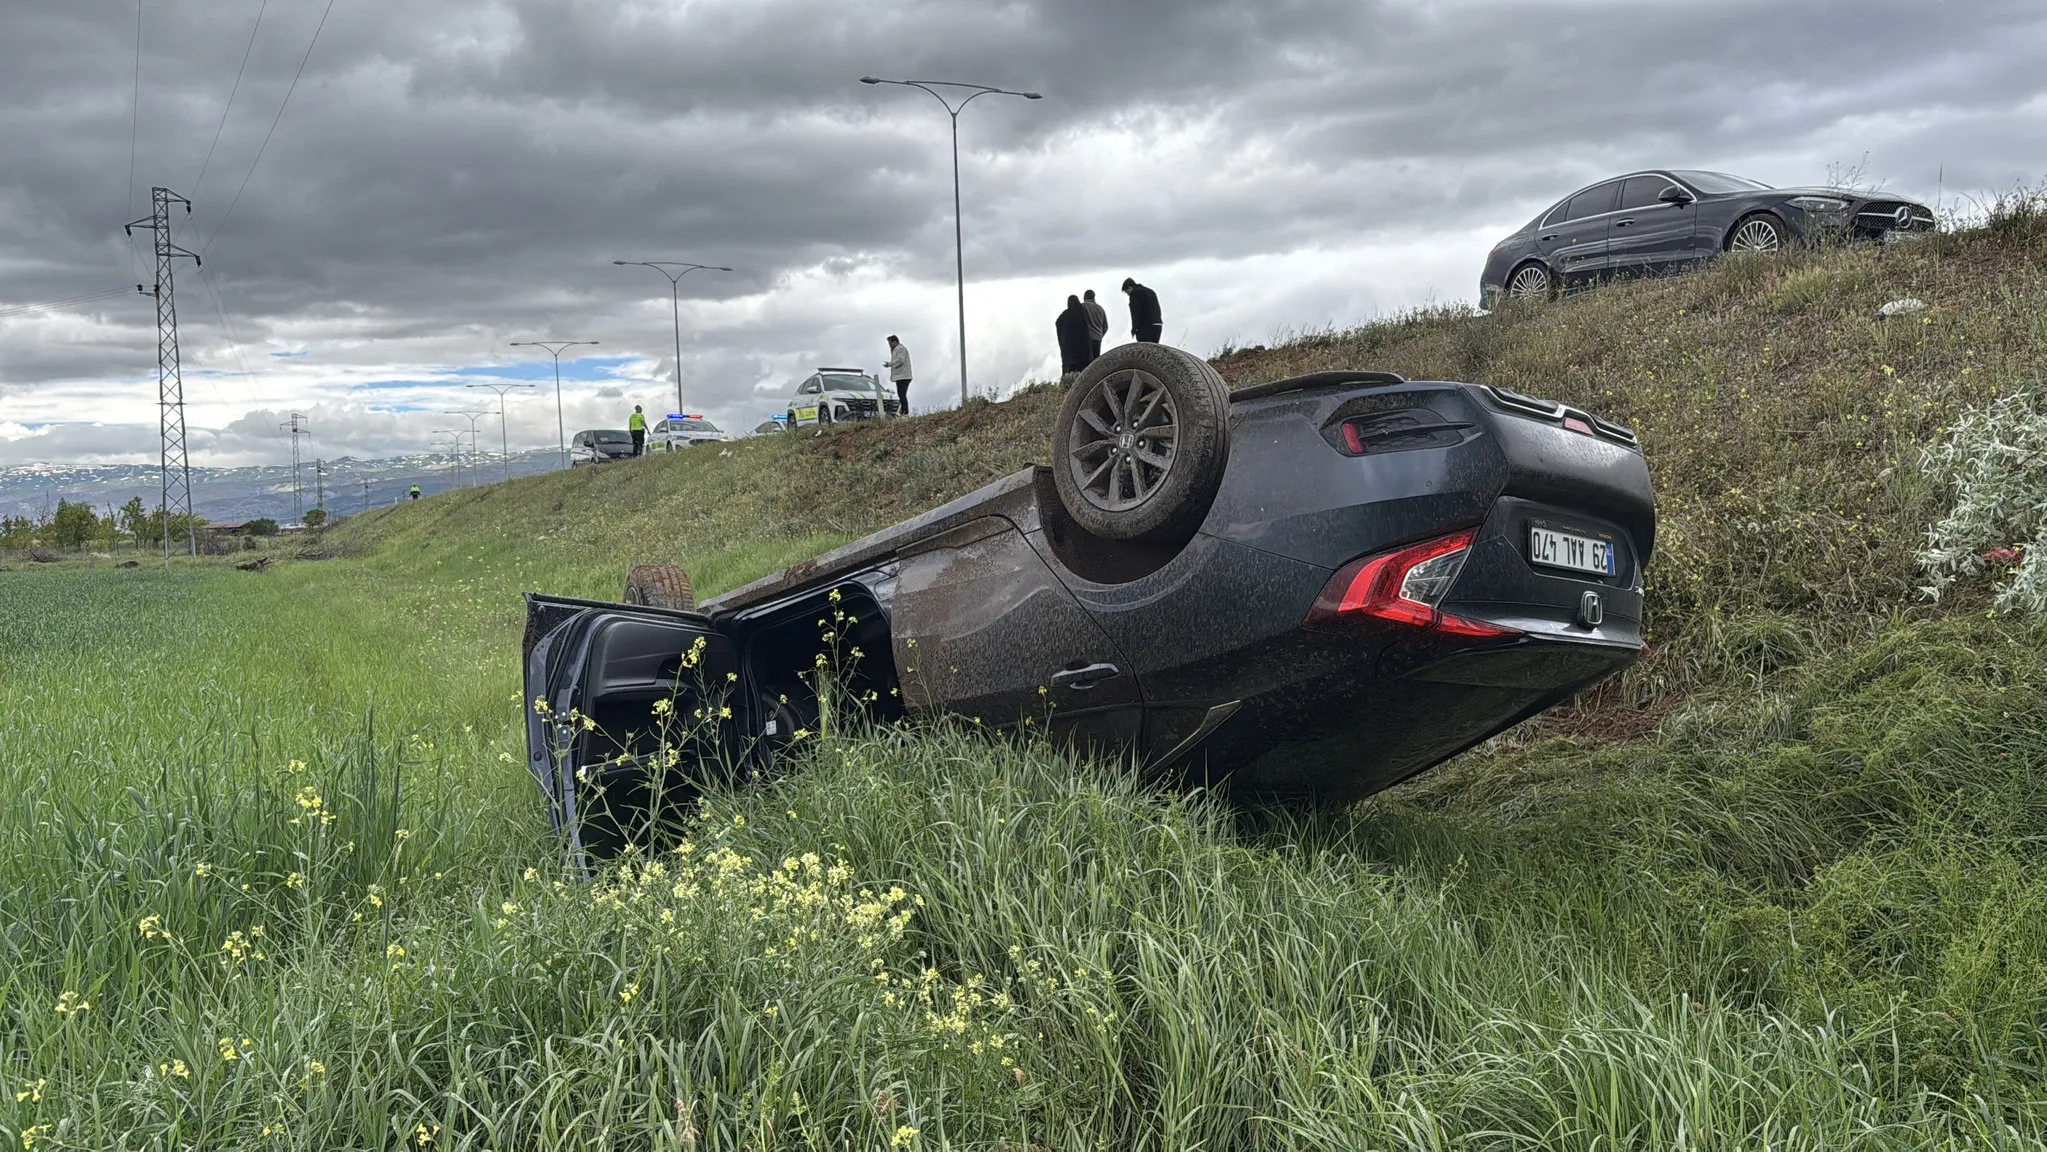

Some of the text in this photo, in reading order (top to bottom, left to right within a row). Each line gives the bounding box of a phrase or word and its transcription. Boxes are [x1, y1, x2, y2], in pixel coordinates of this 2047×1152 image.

[1533, 531, 1607, 570] 29 AAL 470
